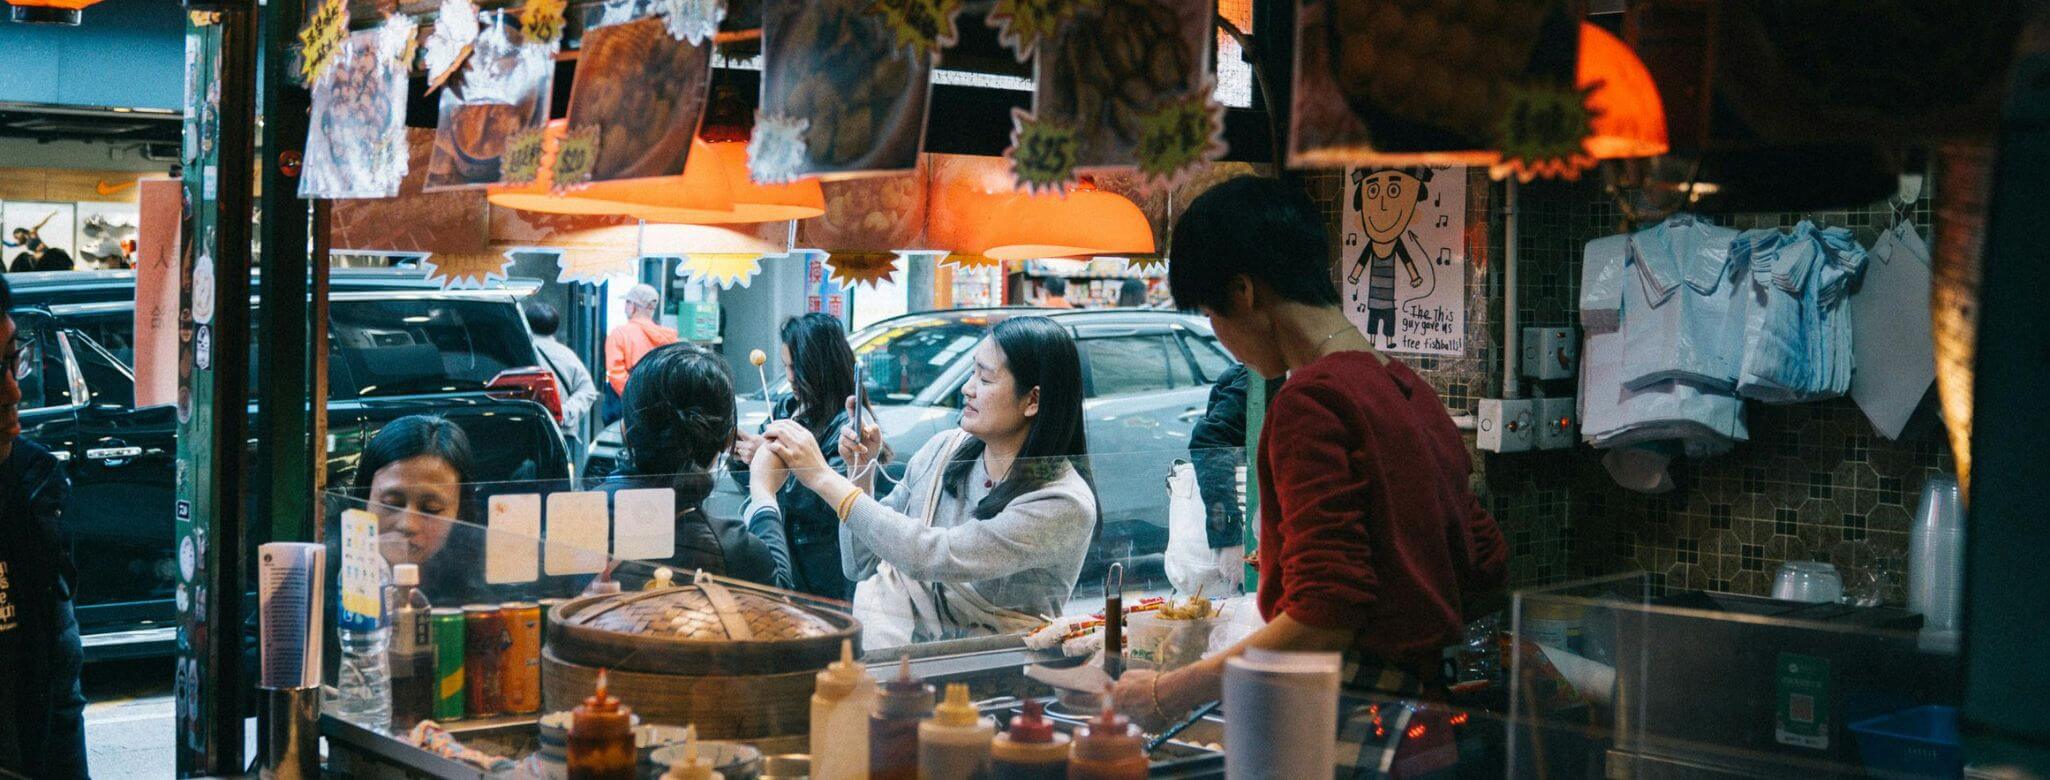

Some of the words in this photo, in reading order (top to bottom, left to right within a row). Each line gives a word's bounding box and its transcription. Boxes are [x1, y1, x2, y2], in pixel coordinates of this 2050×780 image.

[1433, 304, 1454, 322] This
[1402, 318, 1420, 334] guy
[1421, 320, 1440, 336] gave
[1442, 322, 1453, 334] us
